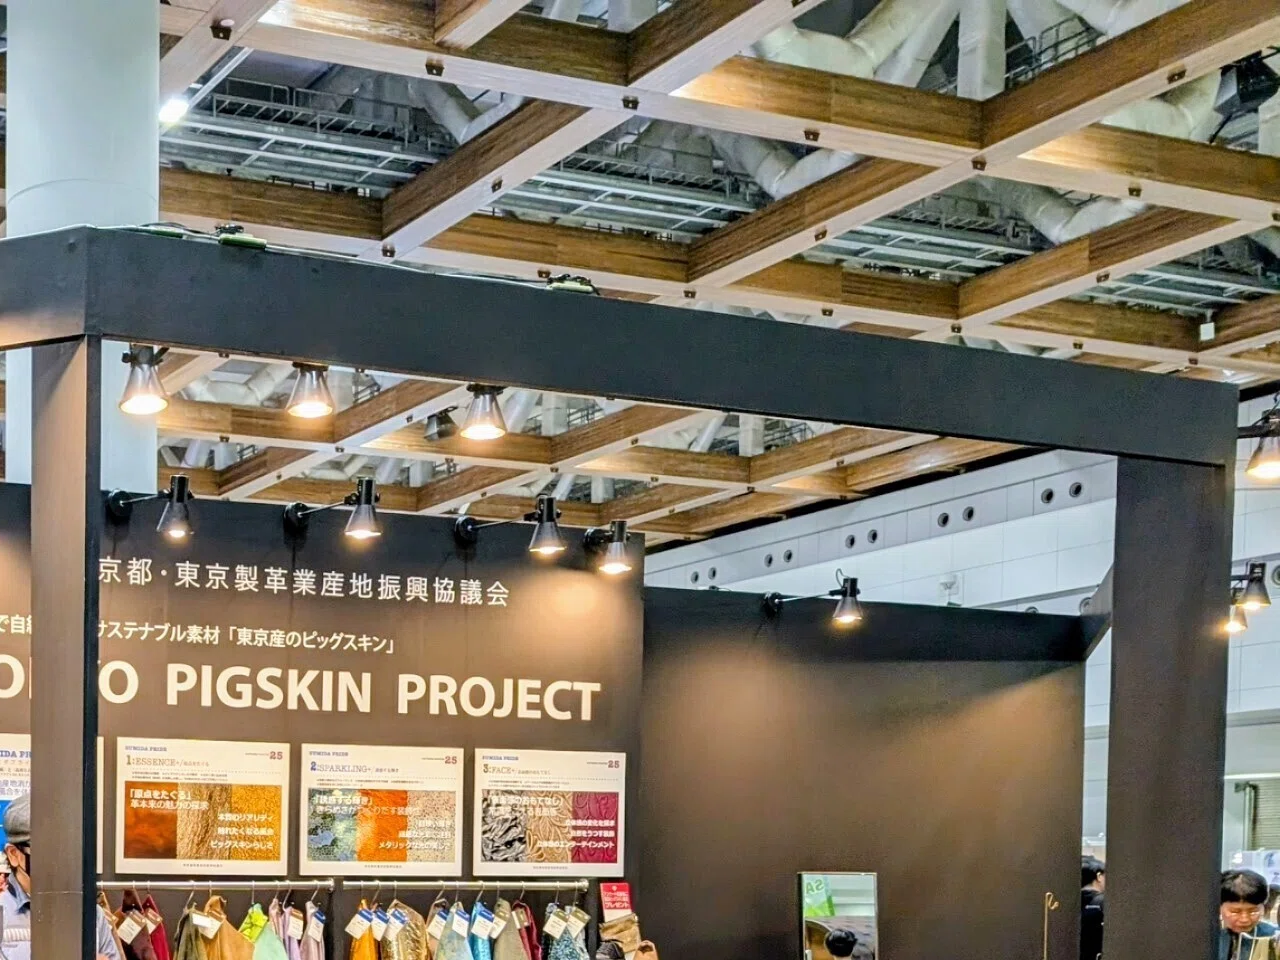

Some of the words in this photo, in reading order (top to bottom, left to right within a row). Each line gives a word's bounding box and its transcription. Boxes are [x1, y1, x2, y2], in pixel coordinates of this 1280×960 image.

[167, 663, 371, 713] PIGSKIN
[397, 673, 601, 721] PROJECT
[269, 751, 283, 760] 25
[444, 756, 458, 764] 25
[608, 760, 620, 768] 25
